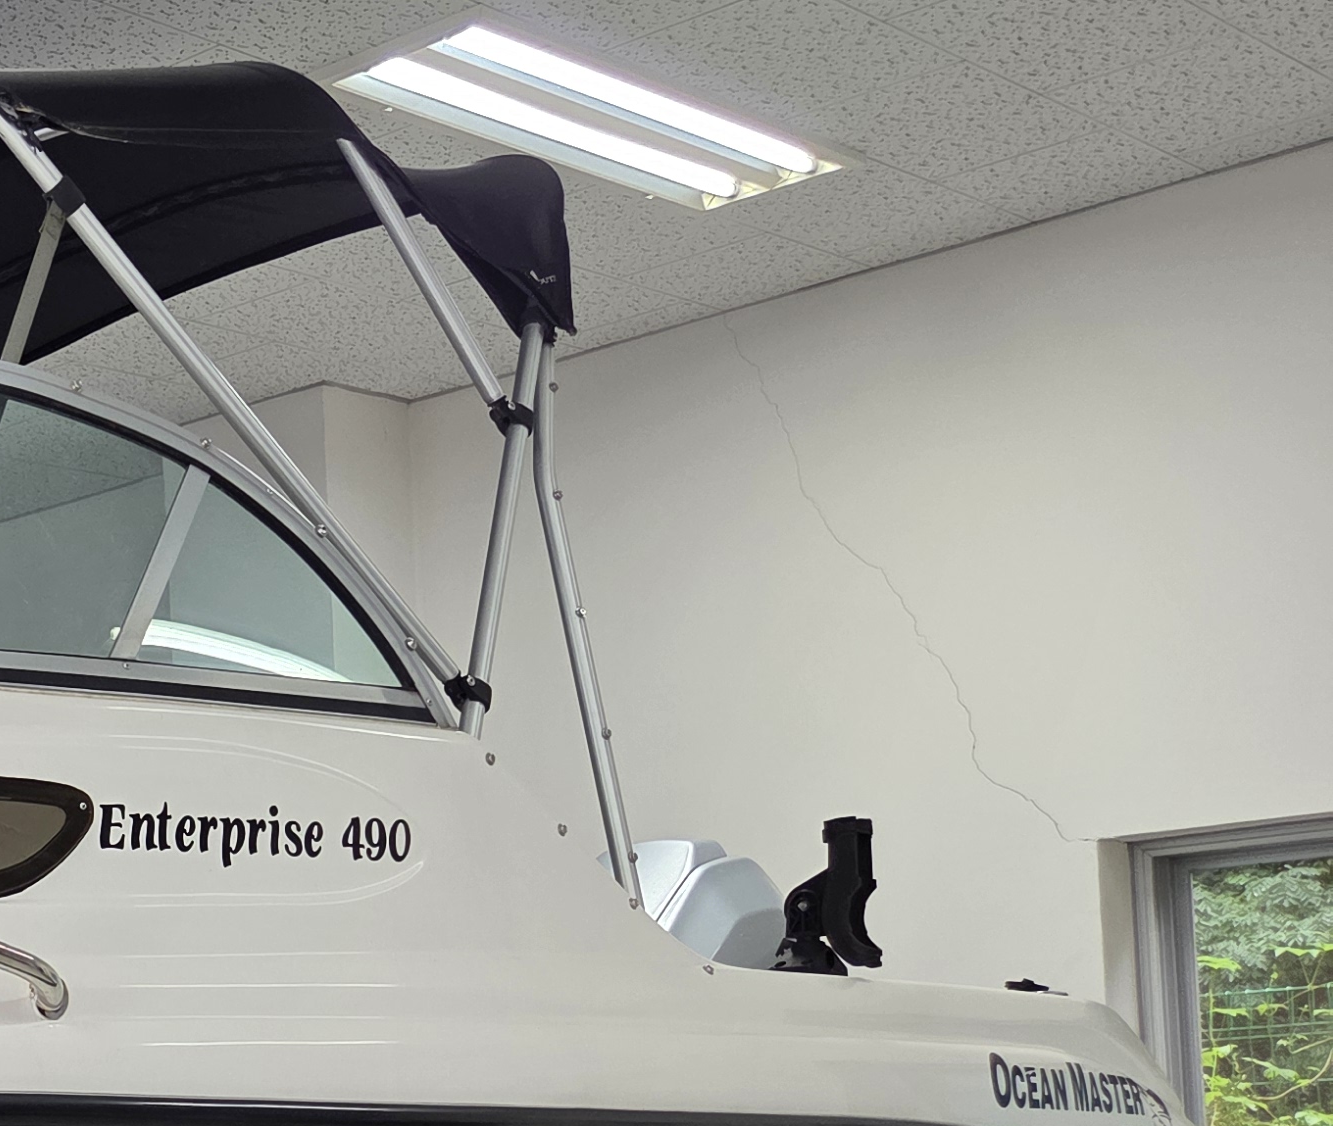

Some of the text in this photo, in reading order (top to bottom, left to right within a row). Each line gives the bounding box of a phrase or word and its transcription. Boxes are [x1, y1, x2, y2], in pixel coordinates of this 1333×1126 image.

[99, 802, 412, 867] Enterprise 490
[989, 1052, 1145, 1115] OCEAN MASTER
